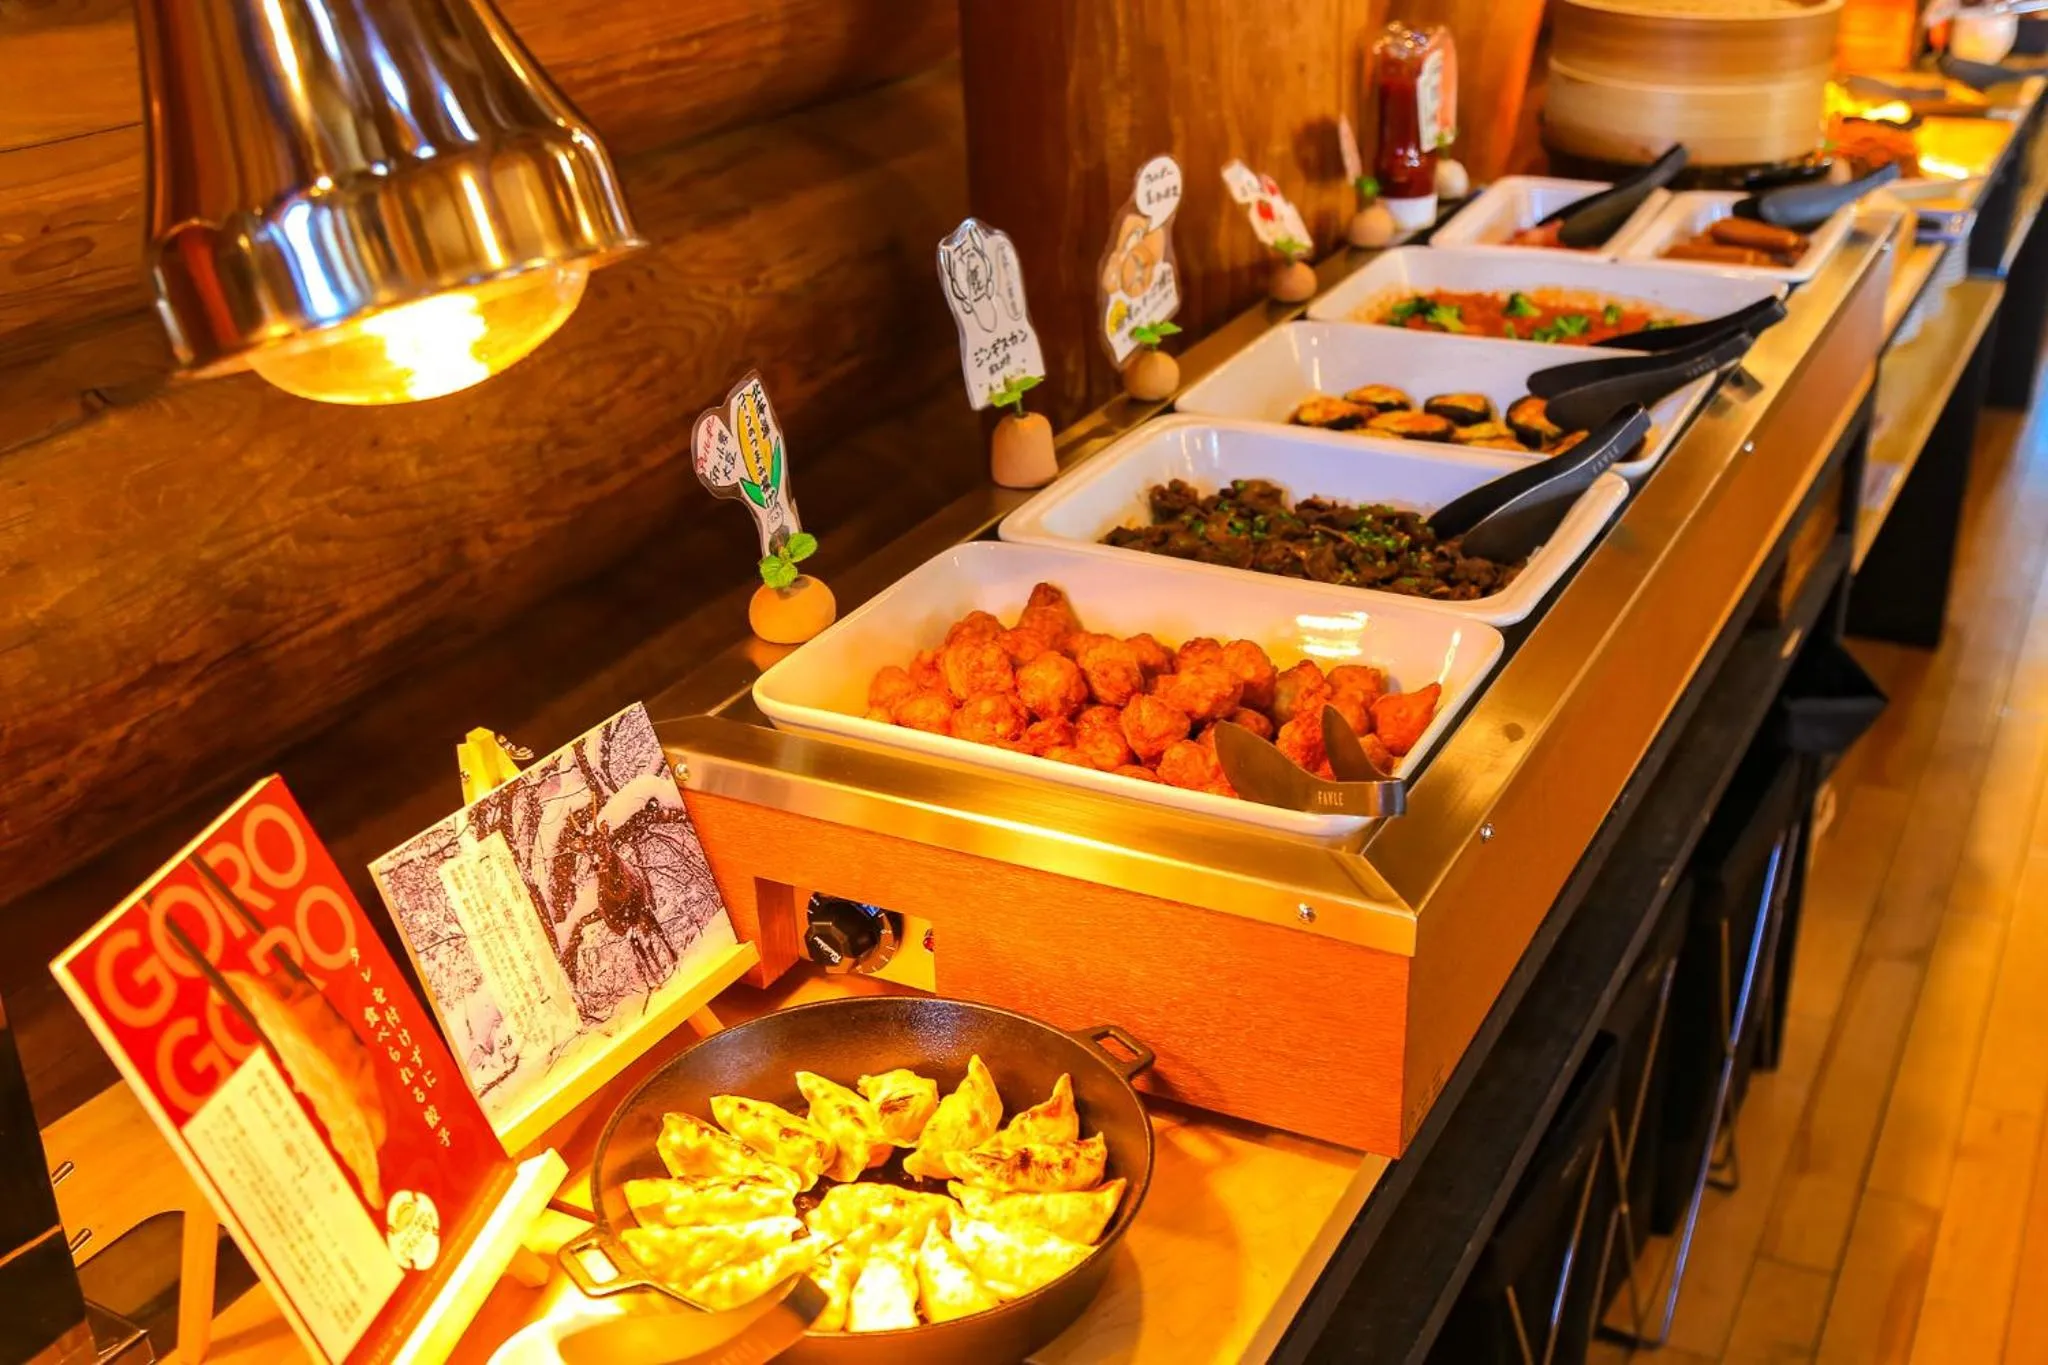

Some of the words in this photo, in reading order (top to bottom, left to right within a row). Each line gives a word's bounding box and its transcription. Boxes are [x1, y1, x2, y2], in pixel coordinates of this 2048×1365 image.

[974, 329, 1028, 368] ジンギスカン
[95, 803, 308, 1028] GORO
[350, 947, 437, 1088] タレを付けずに
[364, 1006, 451, 1147] 食べられる餃子
